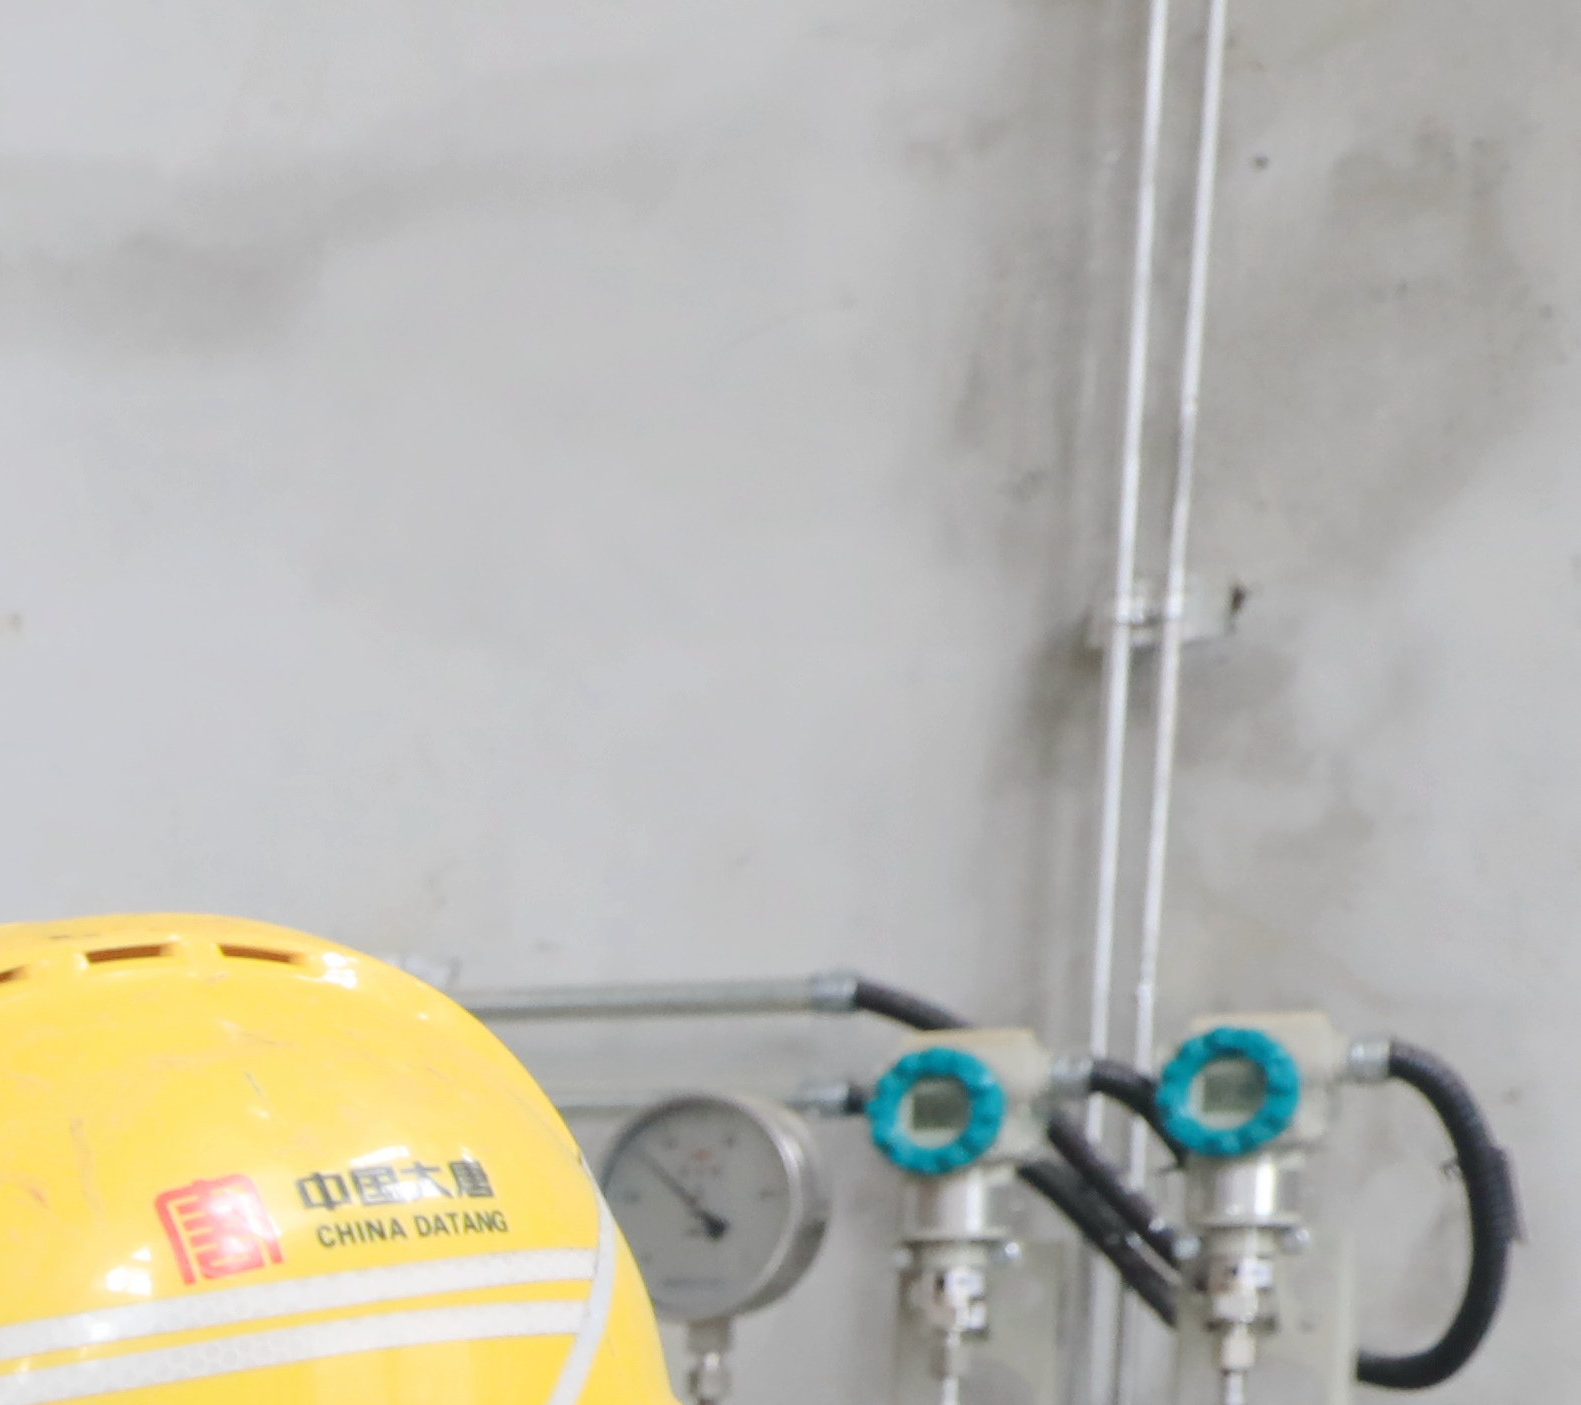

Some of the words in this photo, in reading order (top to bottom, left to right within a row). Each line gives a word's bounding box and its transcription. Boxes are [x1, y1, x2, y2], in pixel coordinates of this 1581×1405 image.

[295, 1160, 494, 1211] 中国大唐
[316, 1216, 407, 1249] CHINA
[414, 1210, 508, 1238] DATANG
